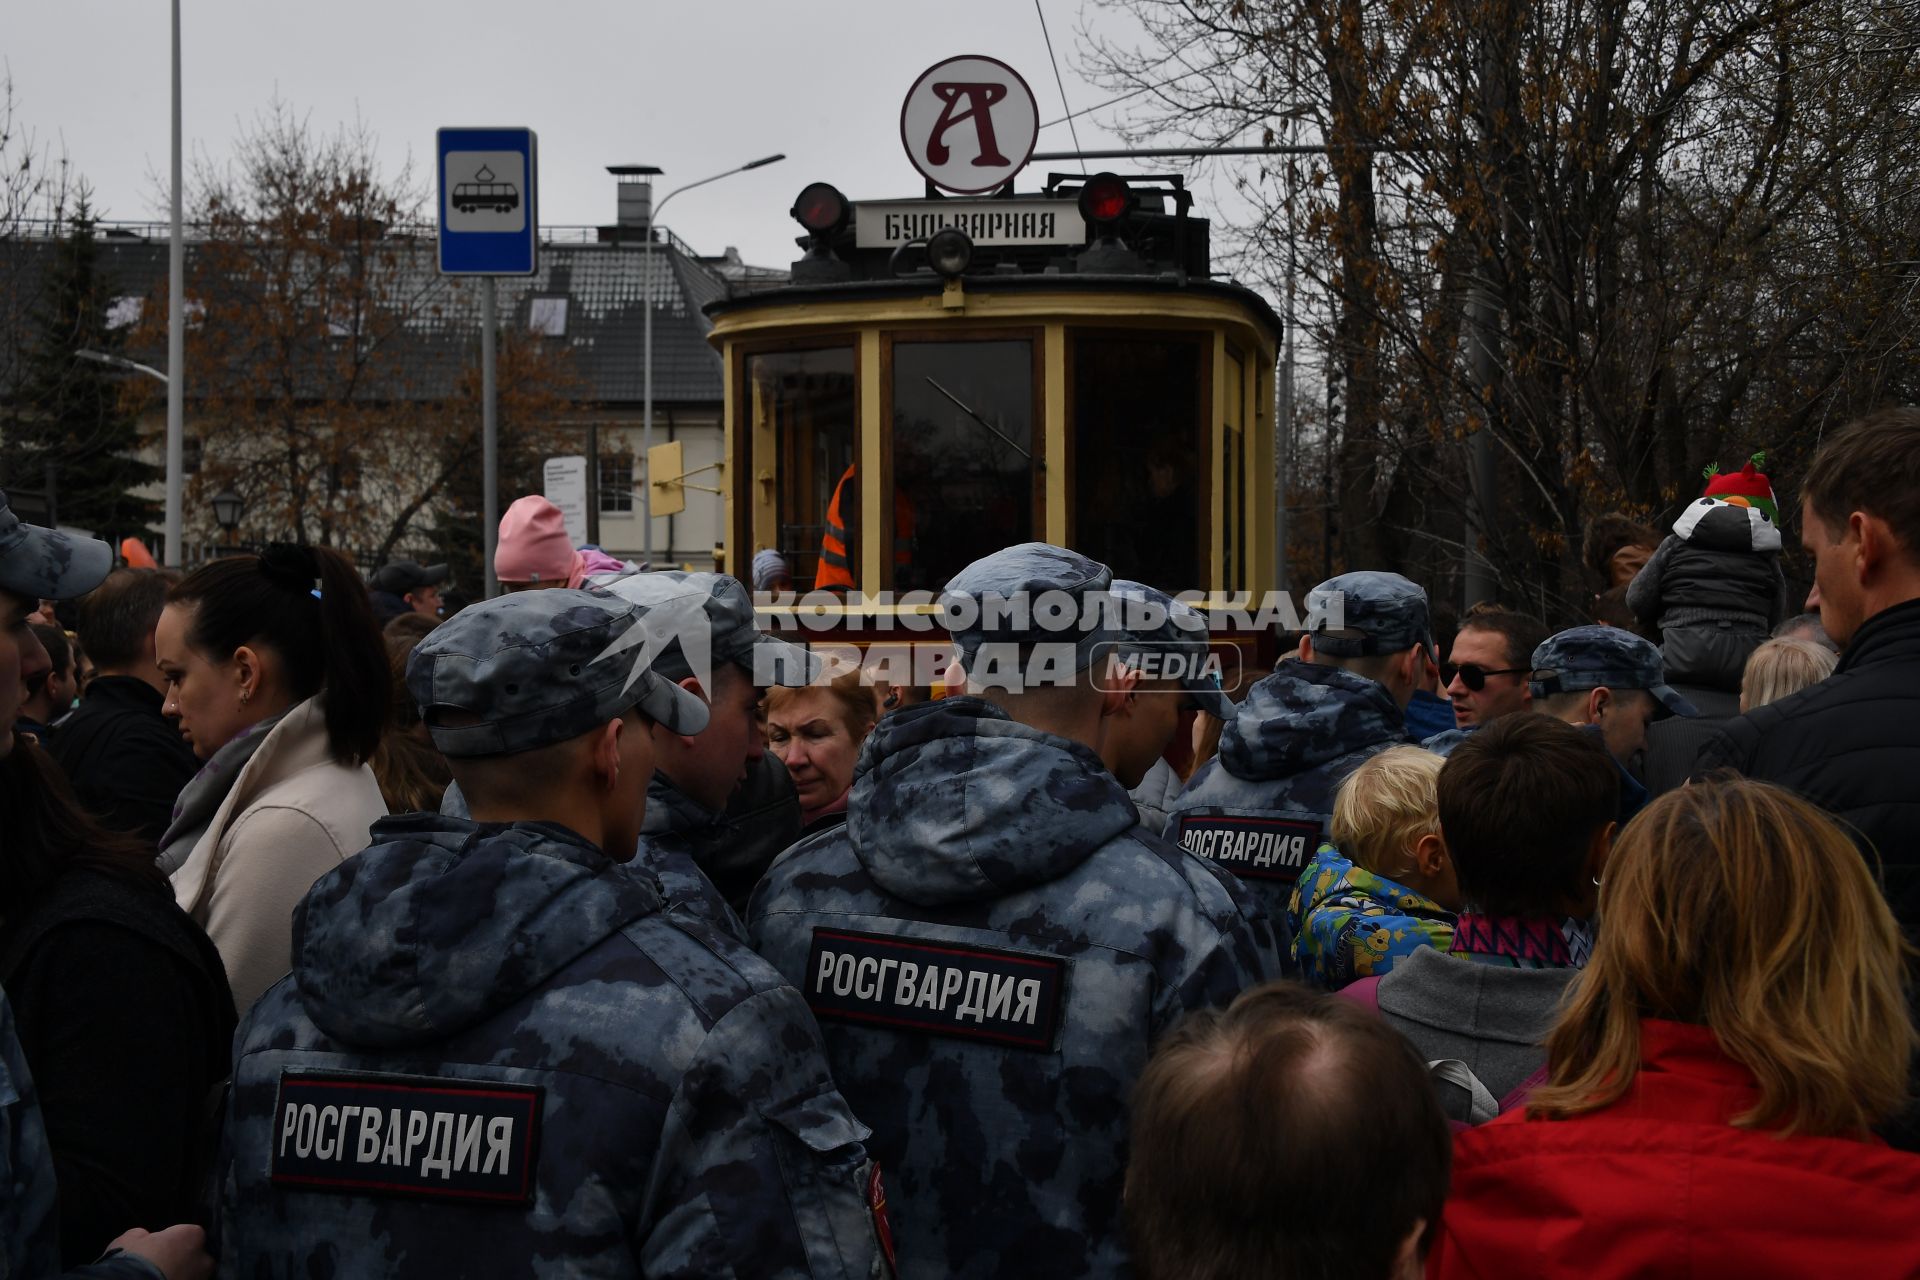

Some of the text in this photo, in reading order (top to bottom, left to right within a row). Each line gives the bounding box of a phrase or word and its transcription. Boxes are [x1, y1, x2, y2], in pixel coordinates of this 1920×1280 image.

[926, 82, 1011, 167] А
[1184, 829, 1306, 868] РОСГВАРДИЯ
[816, 950, 1041, 1025] РОСГВАРДИЯ
[280, 1102, 514, 1180] РОСГВАРДИЯ
